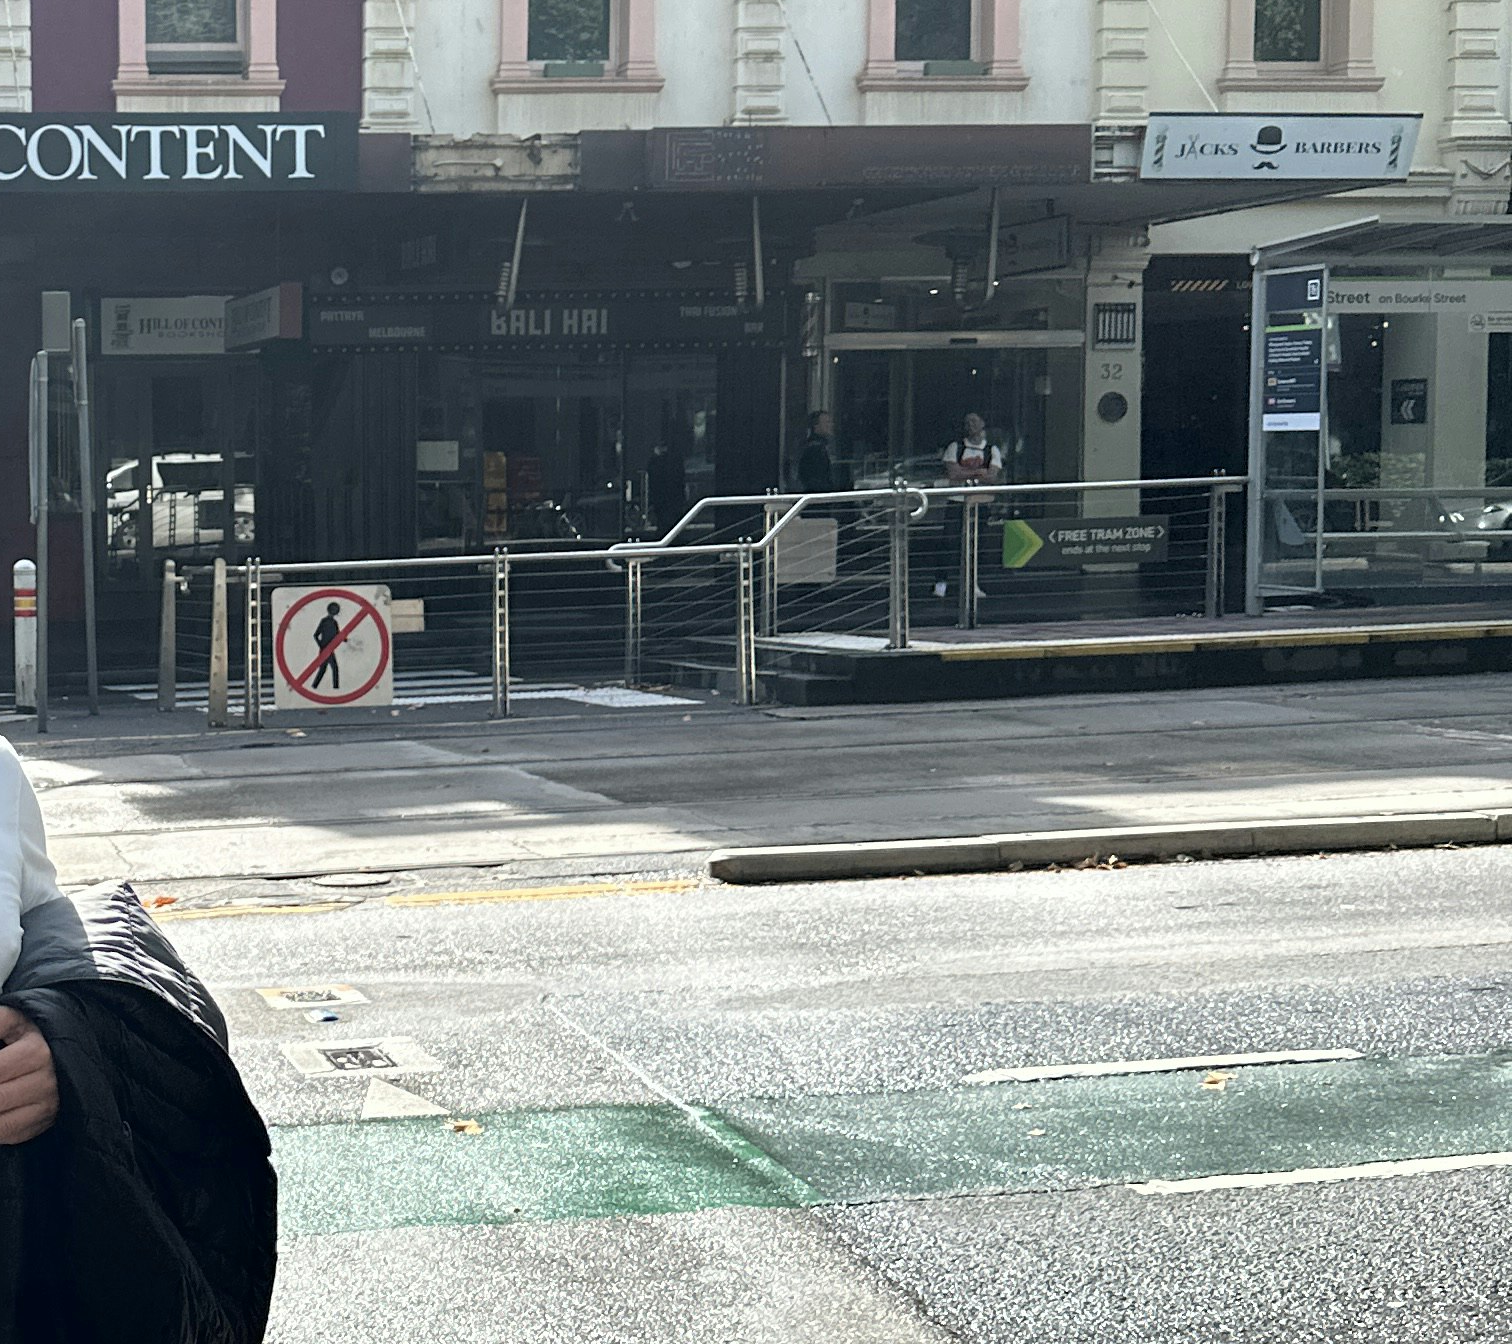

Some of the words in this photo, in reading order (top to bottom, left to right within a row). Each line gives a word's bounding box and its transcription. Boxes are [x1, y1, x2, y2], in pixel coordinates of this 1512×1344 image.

[1175, 134, 1239, 159] JACKS
[1295, 141, 1382, 155] BARBERS
[1327, 290, 1370, 304] Street
[1378, 295, 1393, 304] on
[1395, 292, 1432, 304] Bourke
[1434, 292, 1467, 304] Street
[139, 318, 173, 334] HILL
[175, 318, 190, 331] OF
[192, 318, 224, 331] CONT
[490, 309, 551, 336] BALI
[562, 309, 608, 336] HAI
[158, 330, 224, 338] BOOKSHO
[368, 326, 426, 338] MELBOURNE
[1101, 363, 1123, 380] 32
[1057, 529, 1088, 542] FREE
[1089, 528, 1123, 540] TRAM
[1125, 526, 1155, 539] ZONE
[1061, 545, 1084, 555] ends
